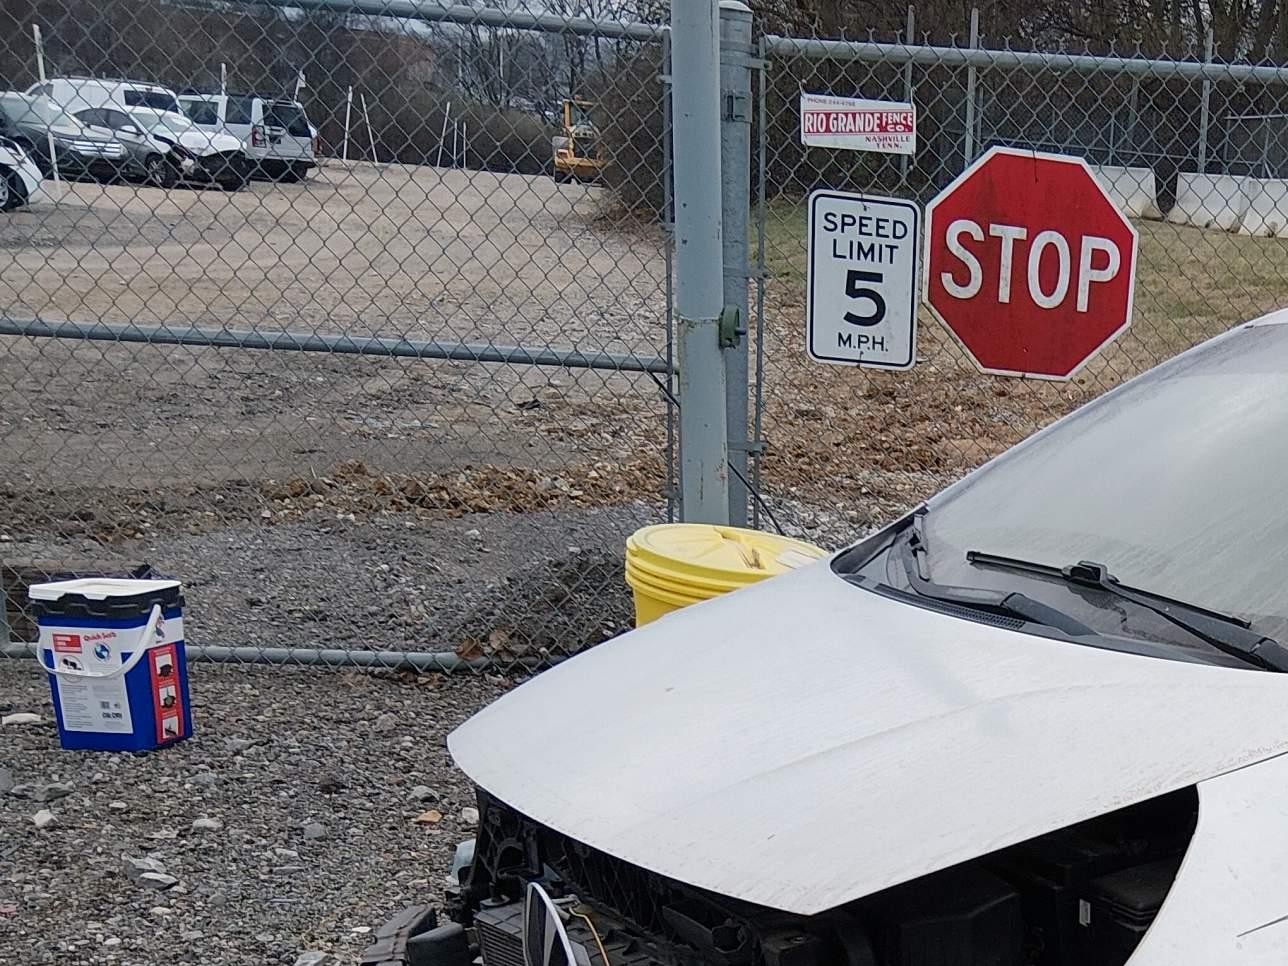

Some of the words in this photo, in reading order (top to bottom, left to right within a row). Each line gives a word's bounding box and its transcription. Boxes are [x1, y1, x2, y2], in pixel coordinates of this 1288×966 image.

[805, 112, 826, 133] RIO
[829, 112, 880, 132] GRANDE
[882, 112, 913, 127] FENCE
[865, 135, 911, 143] NASHVILLE
[823, 211, 908, 240] SPEED
[832, 240, 899, 265] LIMIT
[940, 218, 1121, 313] STOP
[843, 269, 886, 327] 5
[837, 332, 889, 352] M.P.H.
